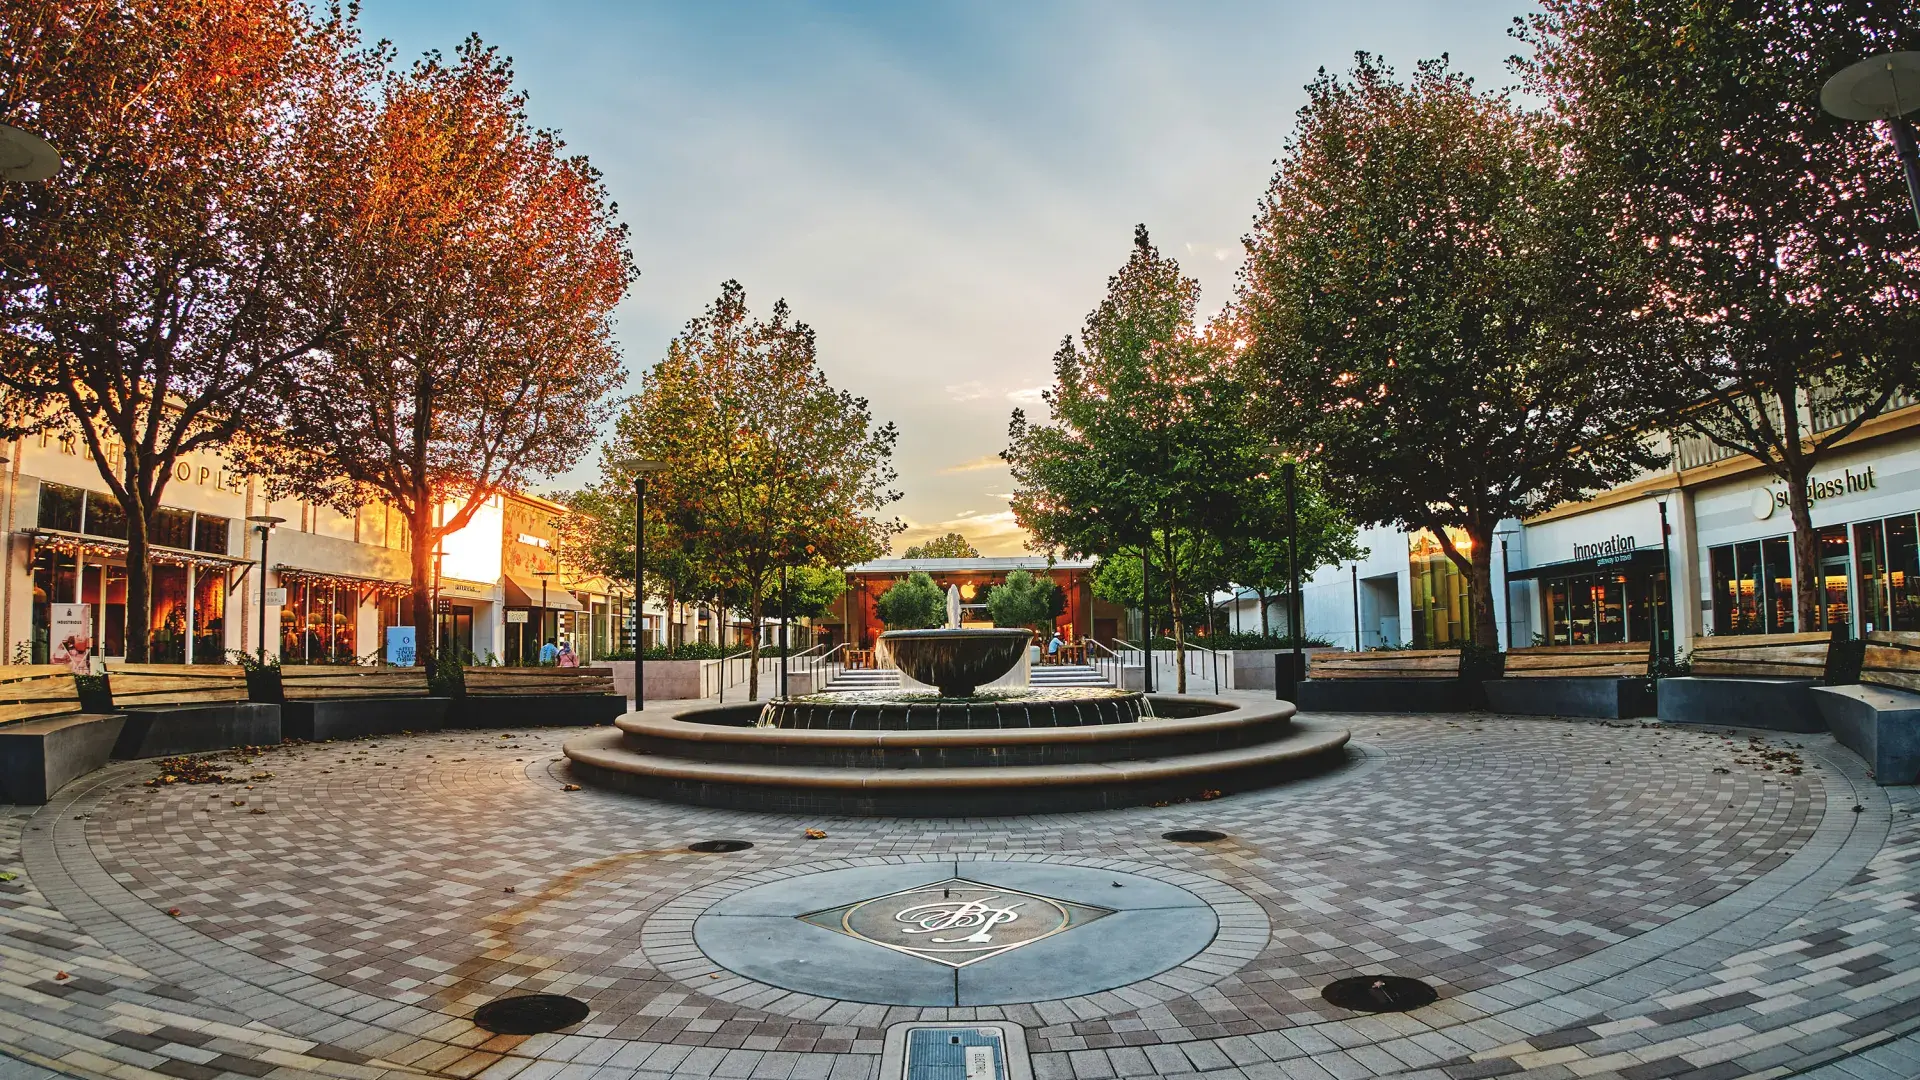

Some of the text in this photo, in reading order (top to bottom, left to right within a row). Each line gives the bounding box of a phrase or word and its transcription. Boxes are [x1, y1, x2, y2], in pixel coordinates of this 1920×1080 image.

[1776, 466, 1876, 509] suglass hut
[1573, 534, 1635, 560] innovation
[1597, 557, 1614, 567] gateway
[1615, 555, 1619, 563] to
